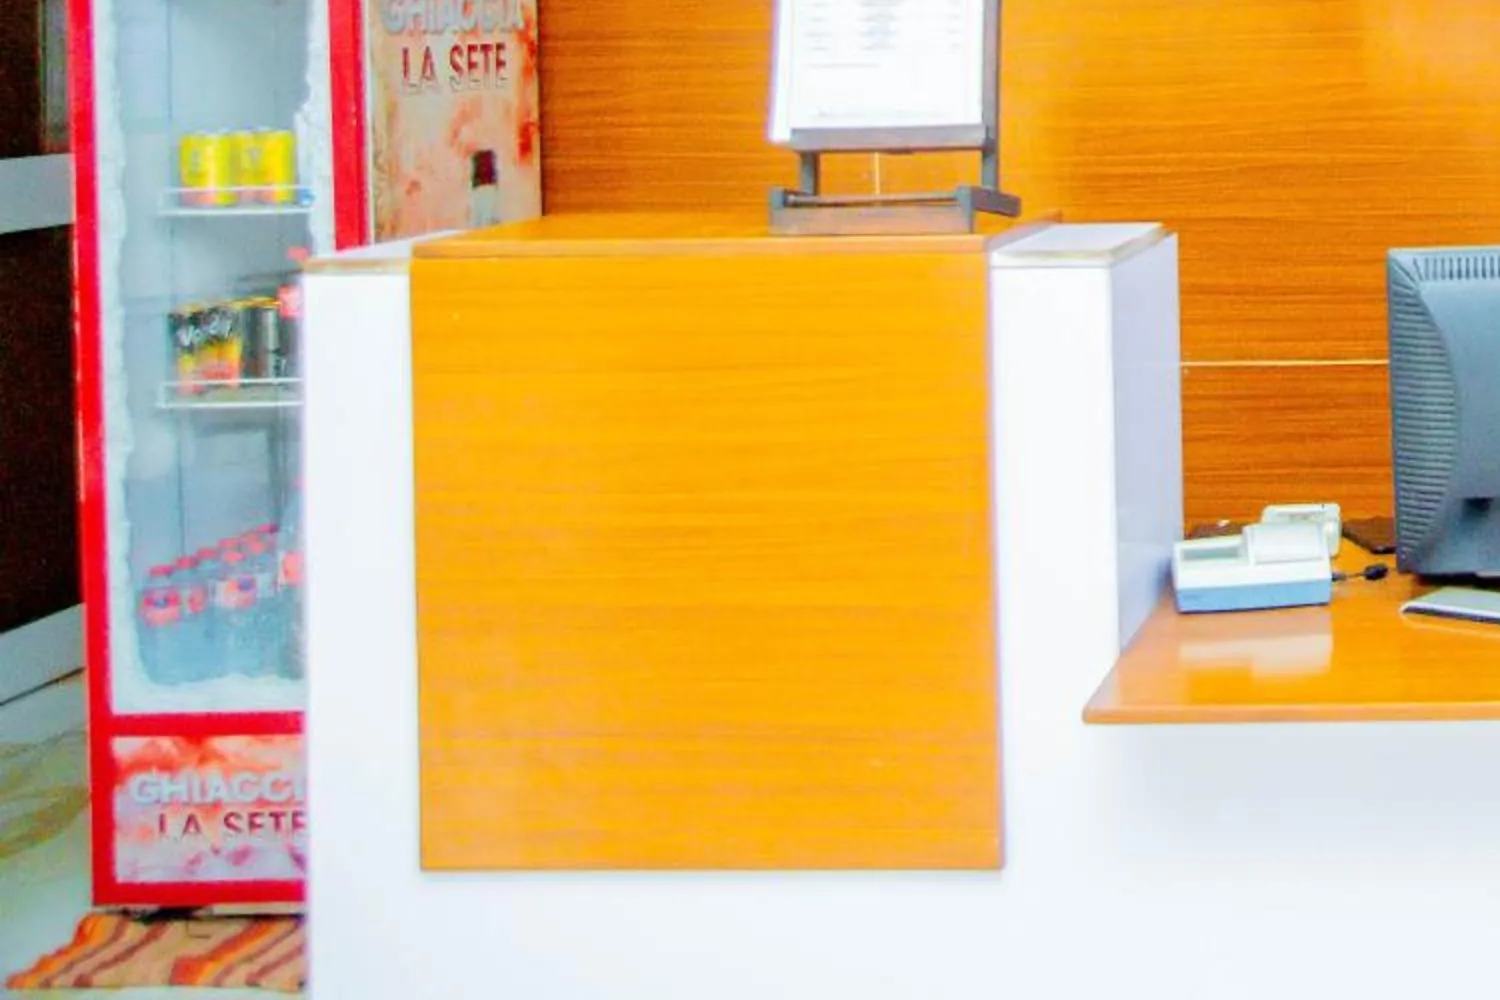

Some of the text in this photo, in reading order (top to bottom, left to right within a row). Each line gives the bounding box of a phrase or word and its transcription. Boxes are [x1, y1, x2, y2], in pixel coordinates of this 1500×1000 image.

[402, 42, 508, 92] LA SETE
[158, 811, 203, 838] LA
